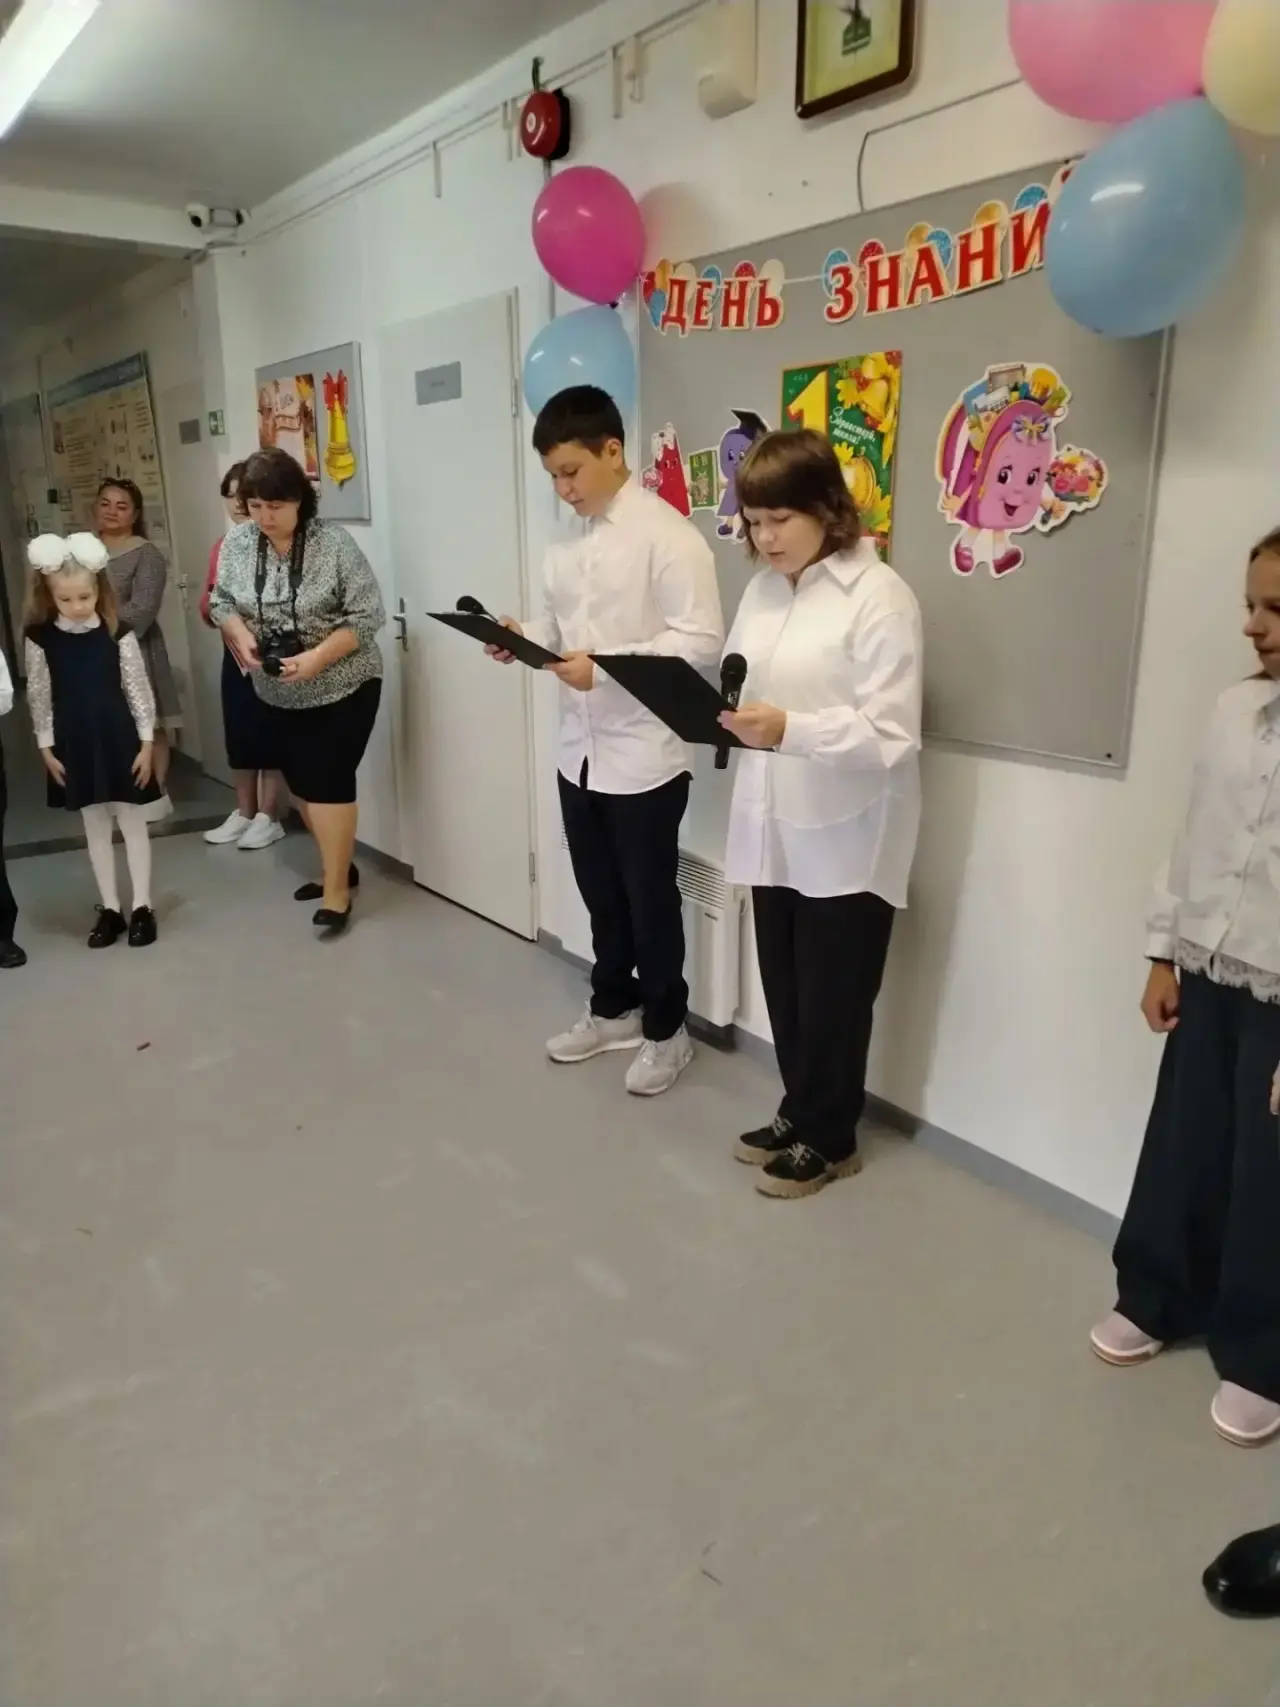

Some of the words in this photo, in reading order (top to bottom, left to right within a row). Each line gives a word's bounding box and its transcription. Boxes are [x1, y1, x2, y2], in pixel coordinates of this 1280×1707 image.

[660, 277, 782, 336] ДЕНЬ
[825, 200, 1051, 323] ЗНАНИ
[786, 369, 829, 437] 1
